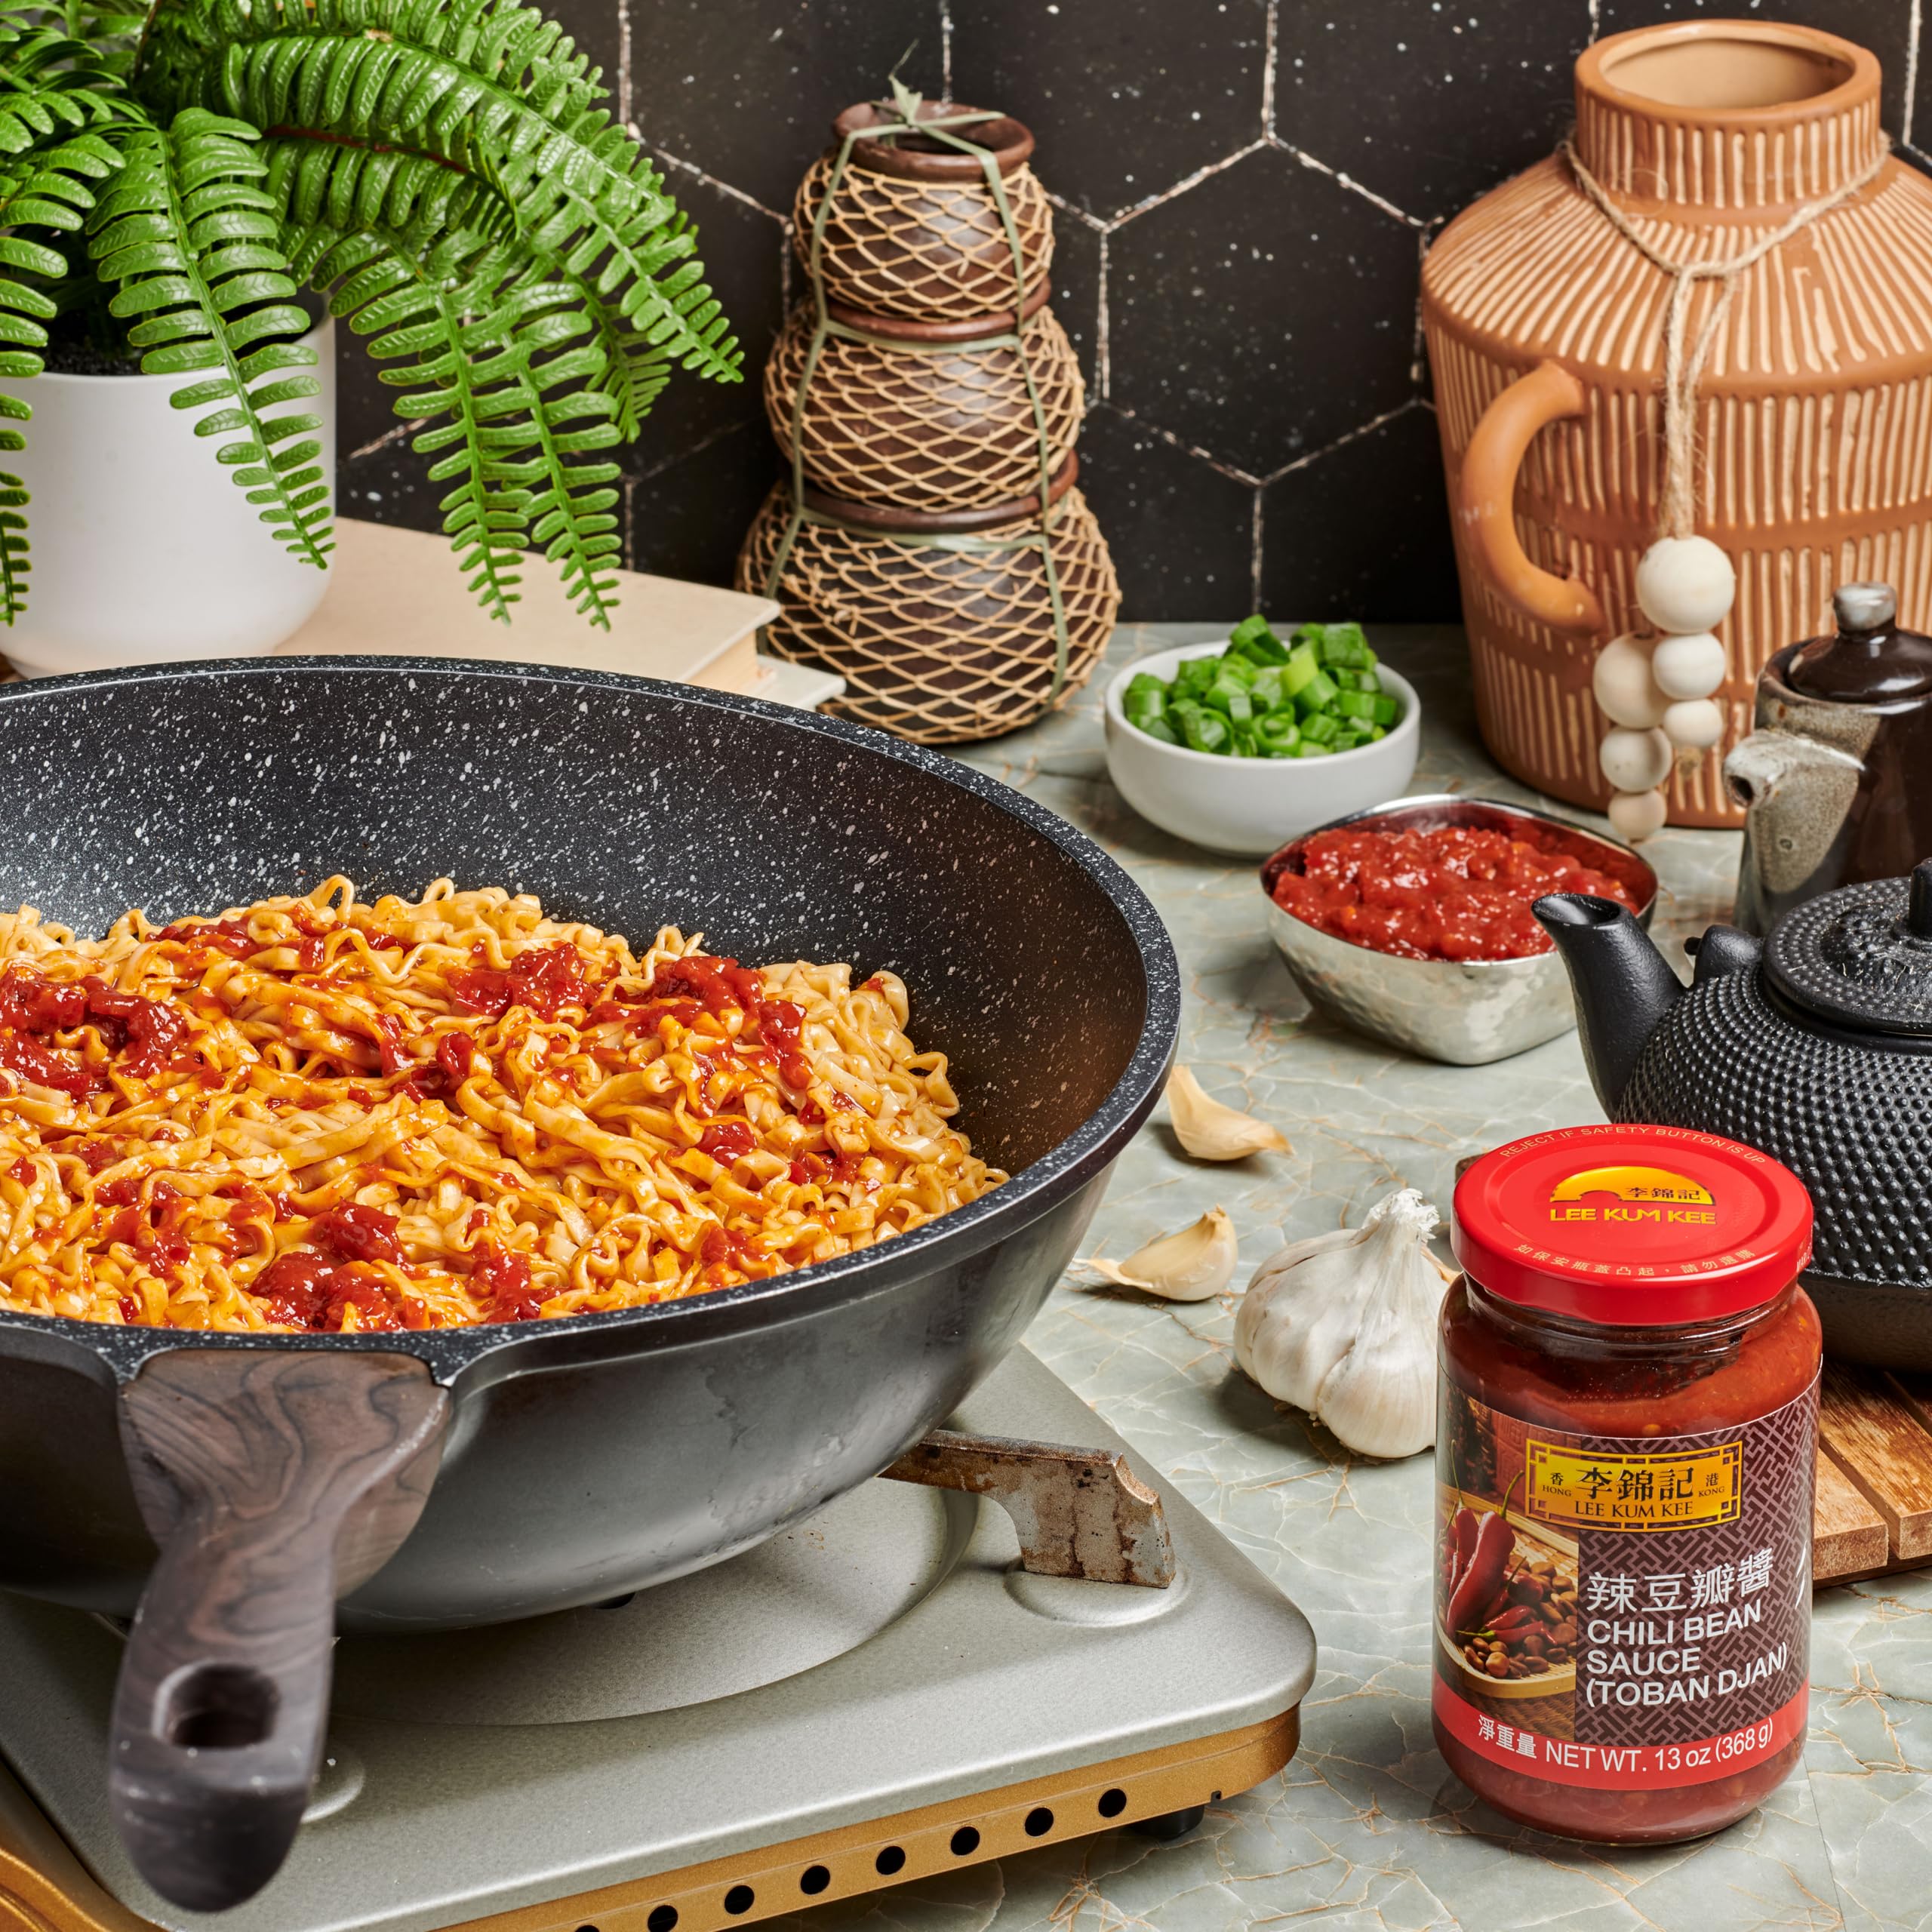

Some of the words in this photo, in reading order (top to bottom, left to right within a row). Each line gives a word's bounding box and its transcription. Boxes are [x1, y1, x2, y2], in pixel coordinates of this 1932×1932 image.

[1500, 1134, 1555, 1157] REJECT
[1581, 1127, 1650, 1135] SAFETY
[1656, 1129, 1725, 1147] BUTTON
[1727, 1145, 1744, 1154] IS
[1743, 1152, 1766, 1163] UP
[1626, 1187, 1700, 1200] 李錦記
[1550, 1208, 1597, 1221] LEE
[1604, 1208, 1661, 1222] KUM
[1668, 1211, 1716, 1224] KEE
[1543, 1484, 1572, 1497] HONG
[1549, 1472, 1564, 1486] 香
[1576, 1466, 1694, 1502] 李錦記
[1698, 1486, 1725, 1497] KONG
[1706, 1472, 1719, 1487] 港
[1575, 1500, 1604, 1516] LEE
[1612, 1504, 1655, 1518] KUM
[1662, 1501, 1694, 1517] KEE
[1586, 1548, 1774, 1614] 辣豆瓣醬
[1587, 1620, 1674, 1645] CHILI
[1684, 1598, 1761, 1641] BEAN
[1586, 1647, 1701, 1676] SAUCE
[1586, 1675, 1709, 1708] (TOBAN
[1718, 1641, 1788, 1695] DJAN)
[1478, 1715, 1537, 1759] 淨重量
[1546, 1740, 1596, 1769] NET
[1601, 1749, 1647, 1772] WT.
[1655, 1747, 1681, 1770] 13
[1685, 1746, 1711, 1767] oz
[1715, 1728, 1755, 1762] (368
[1758, 1718, 1774, 1750] g)
